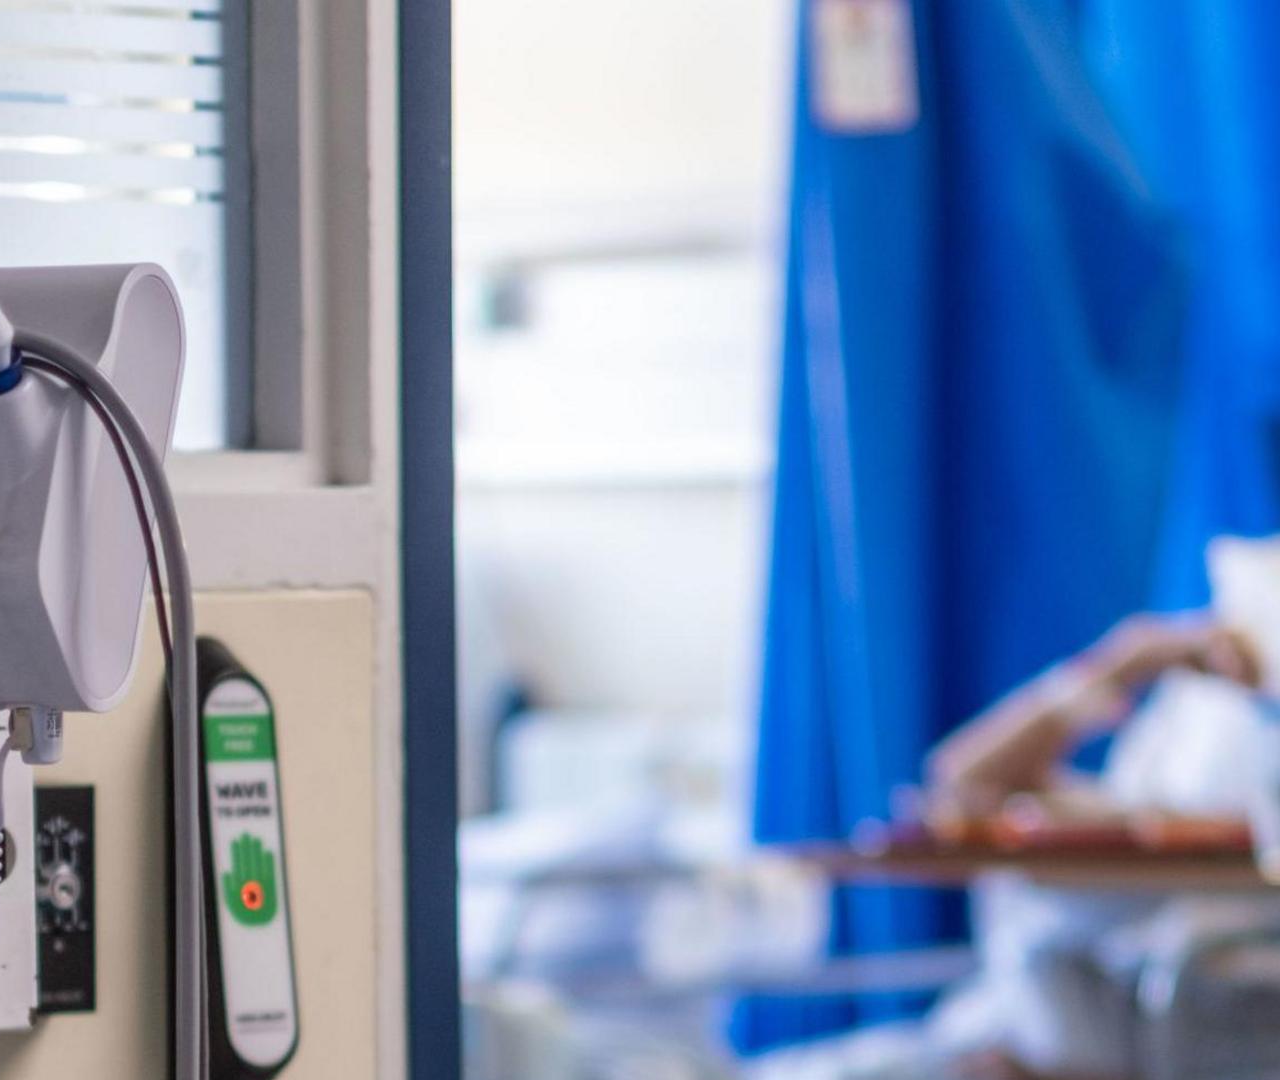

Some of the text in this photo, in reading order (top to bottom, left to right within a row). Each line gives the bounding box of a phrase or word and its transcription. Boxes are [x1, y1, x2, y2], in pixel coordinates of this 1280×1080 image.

[216, 782, 268, 799] WAVE
[217, 804, 272, 818] TO OPEN
